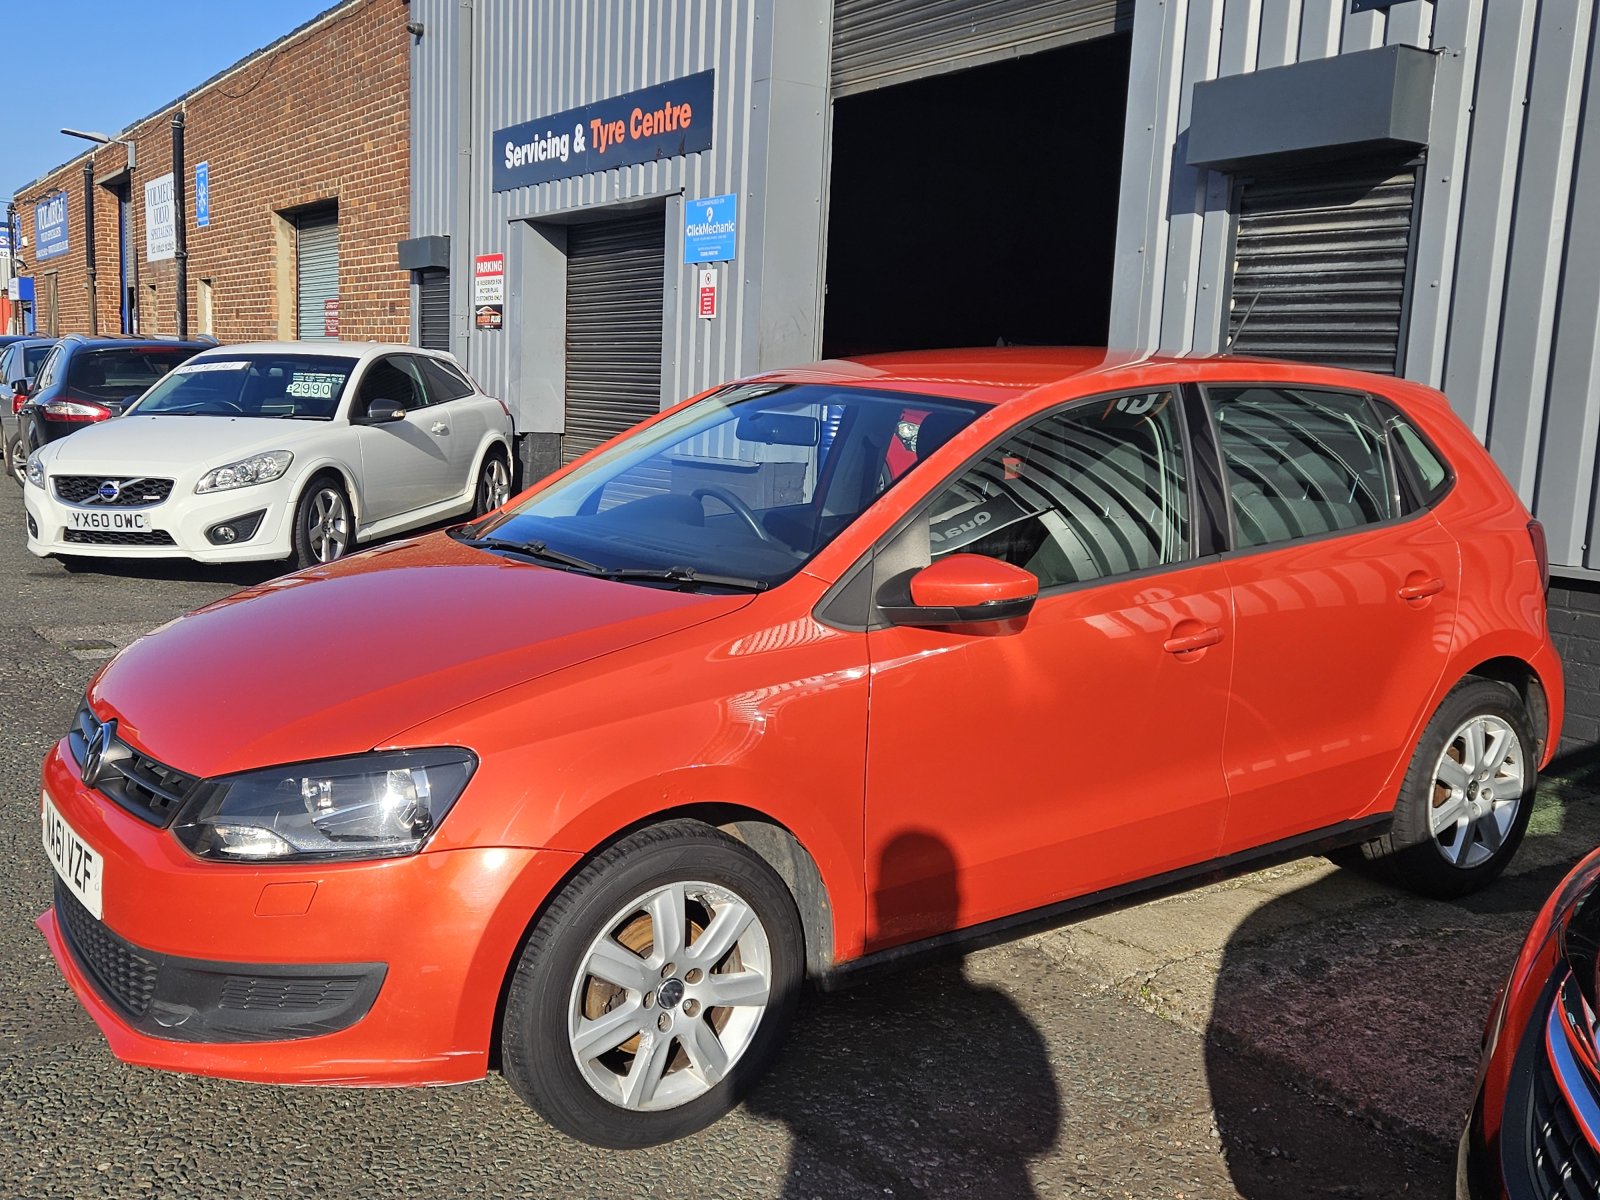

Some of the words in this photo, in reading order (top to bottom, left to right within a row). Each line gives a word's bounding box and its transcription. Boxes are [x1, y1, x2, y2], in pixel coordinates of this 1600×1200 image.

[505, 130, 569, 169] Servicing
[573, 123, 586, 153] &
[590, 117, 625, 154] Tyre
[630, 101, 692, 140] Centre
[687, 220, 735, 237] ClickMechanic
[476, 260, 503, 273] PARKING
[72, 512, 110, 528] YX60
[114, 513, 144, 528] OWC
[46, 801, 65, 868] NA61
[67, 831, 93, 894] VZF
